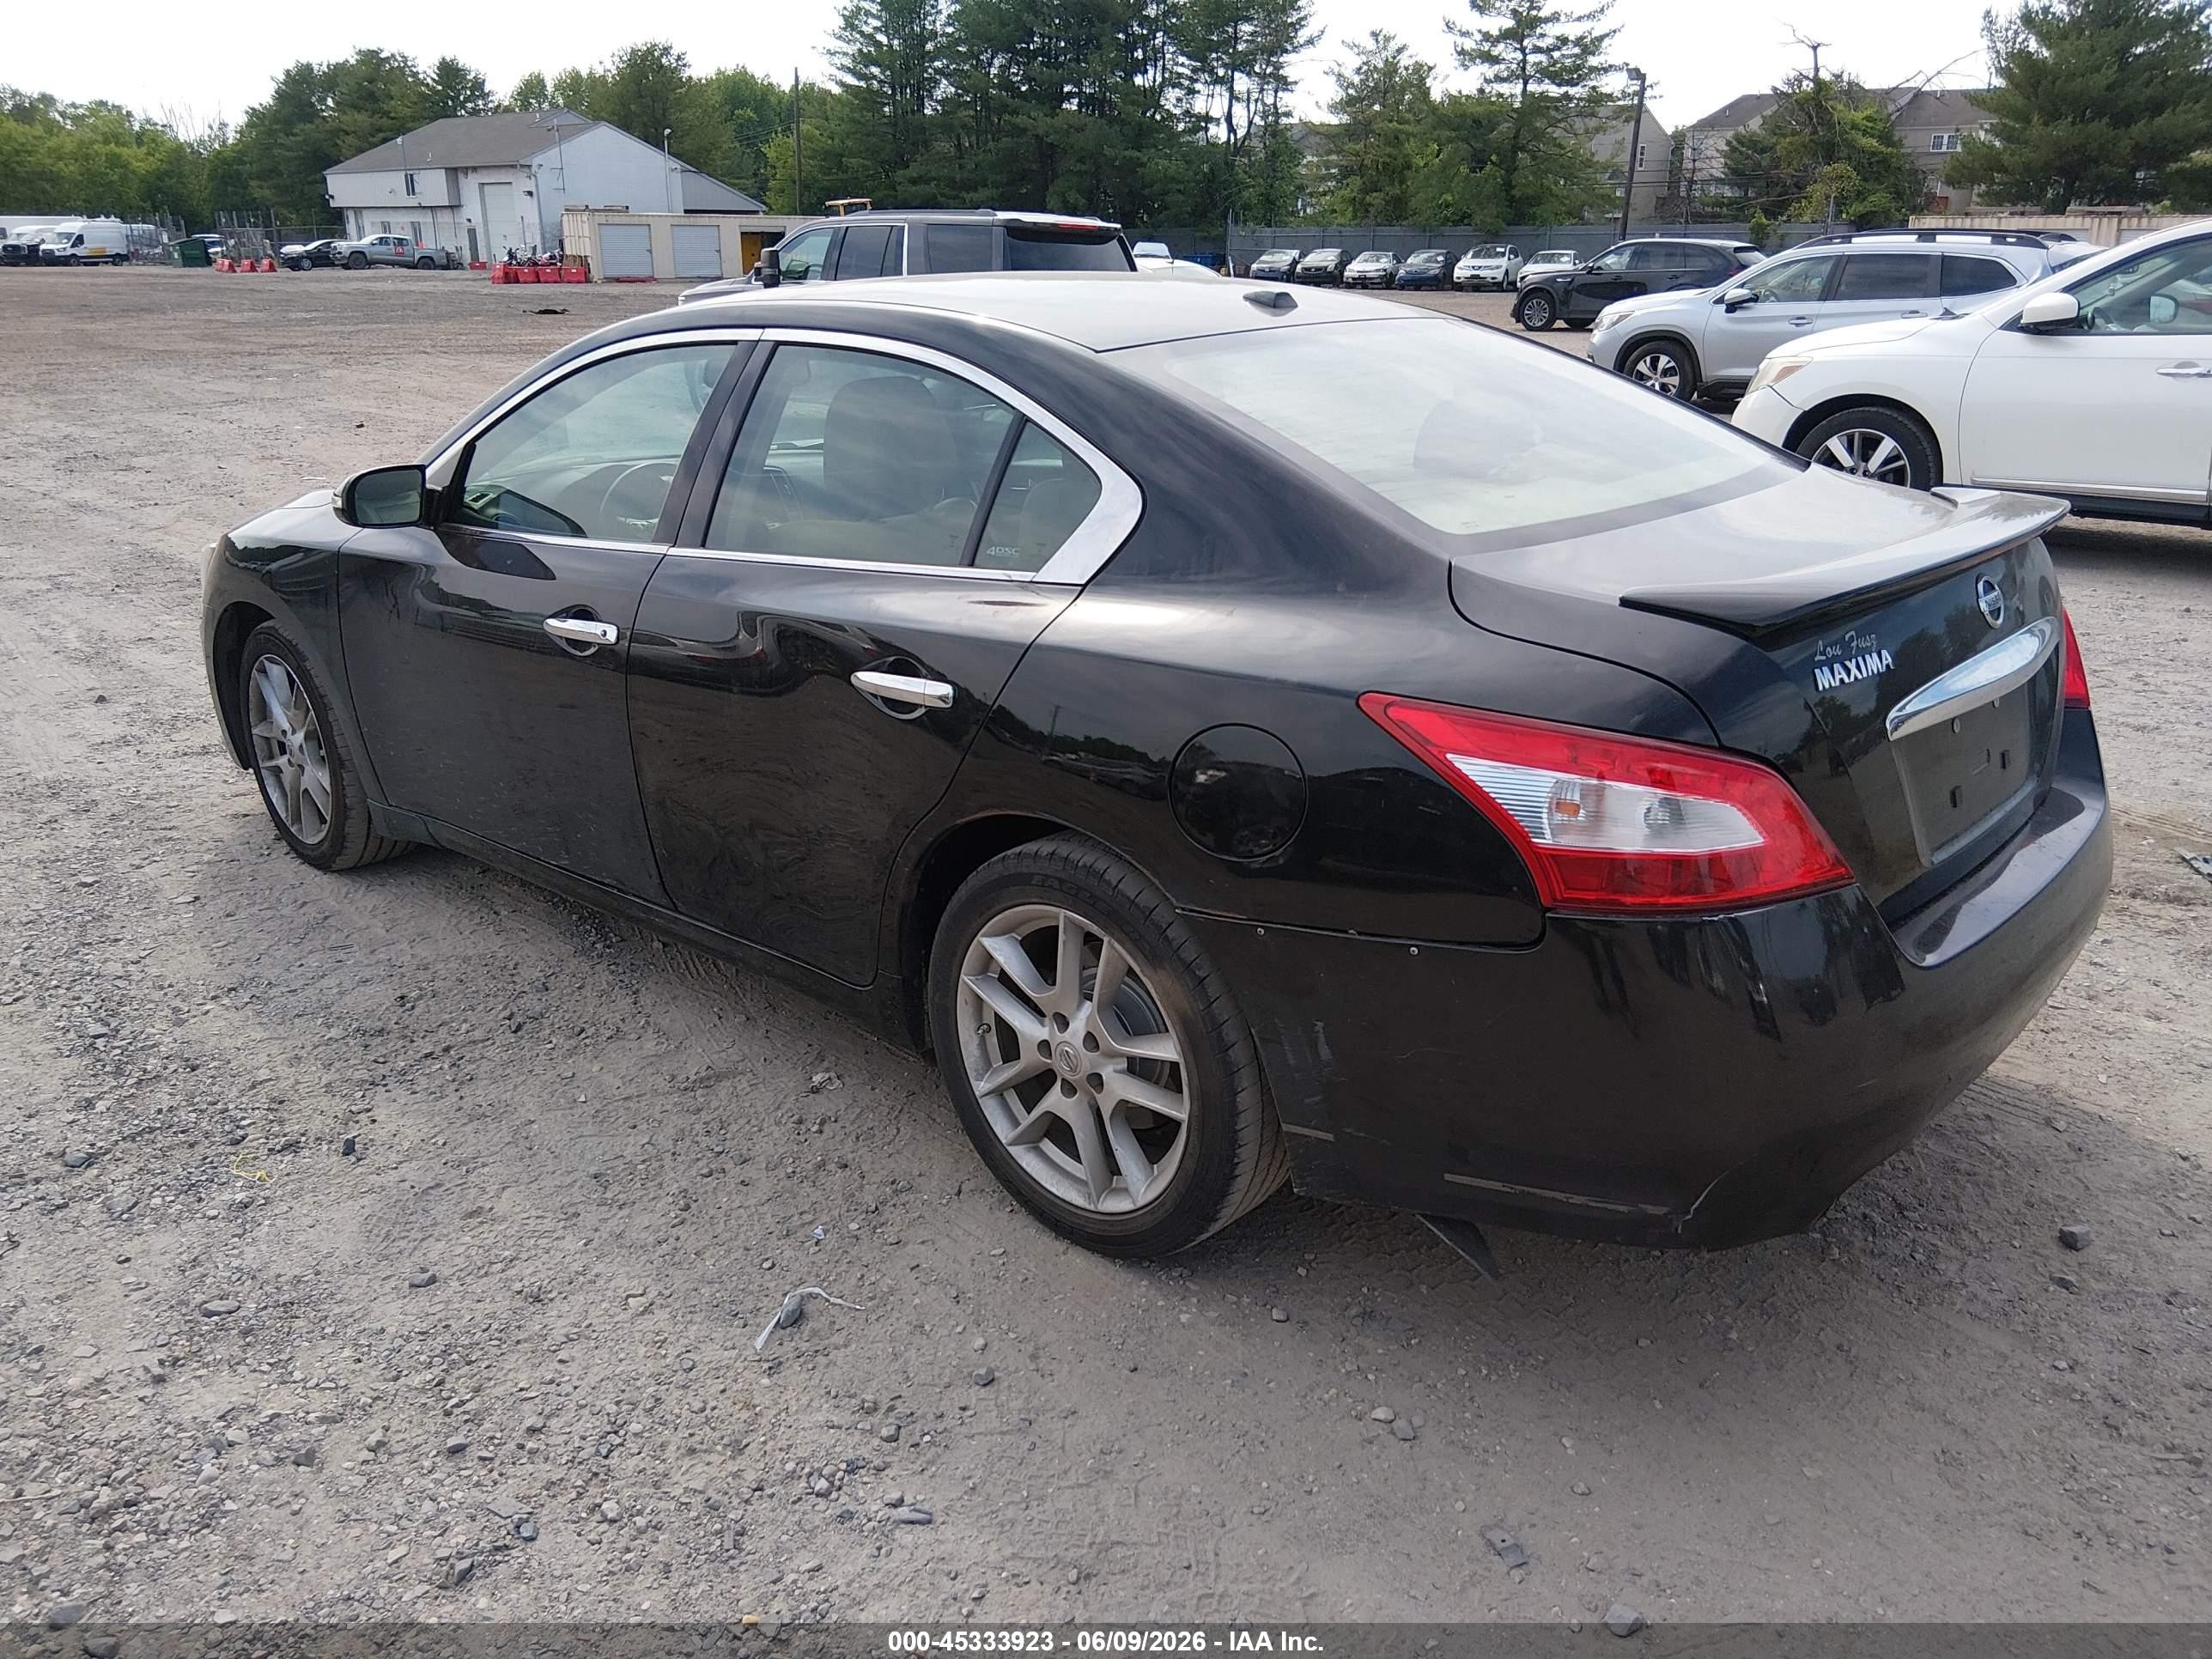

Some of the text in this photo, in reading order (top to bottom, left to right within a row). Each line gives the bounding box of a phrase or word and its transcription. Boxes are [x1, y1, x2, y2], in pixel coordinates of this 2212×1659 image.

[1814, 631, 1876, 660] Lou Fusz
[1814, 649, 1895, 691] MAXIMA
